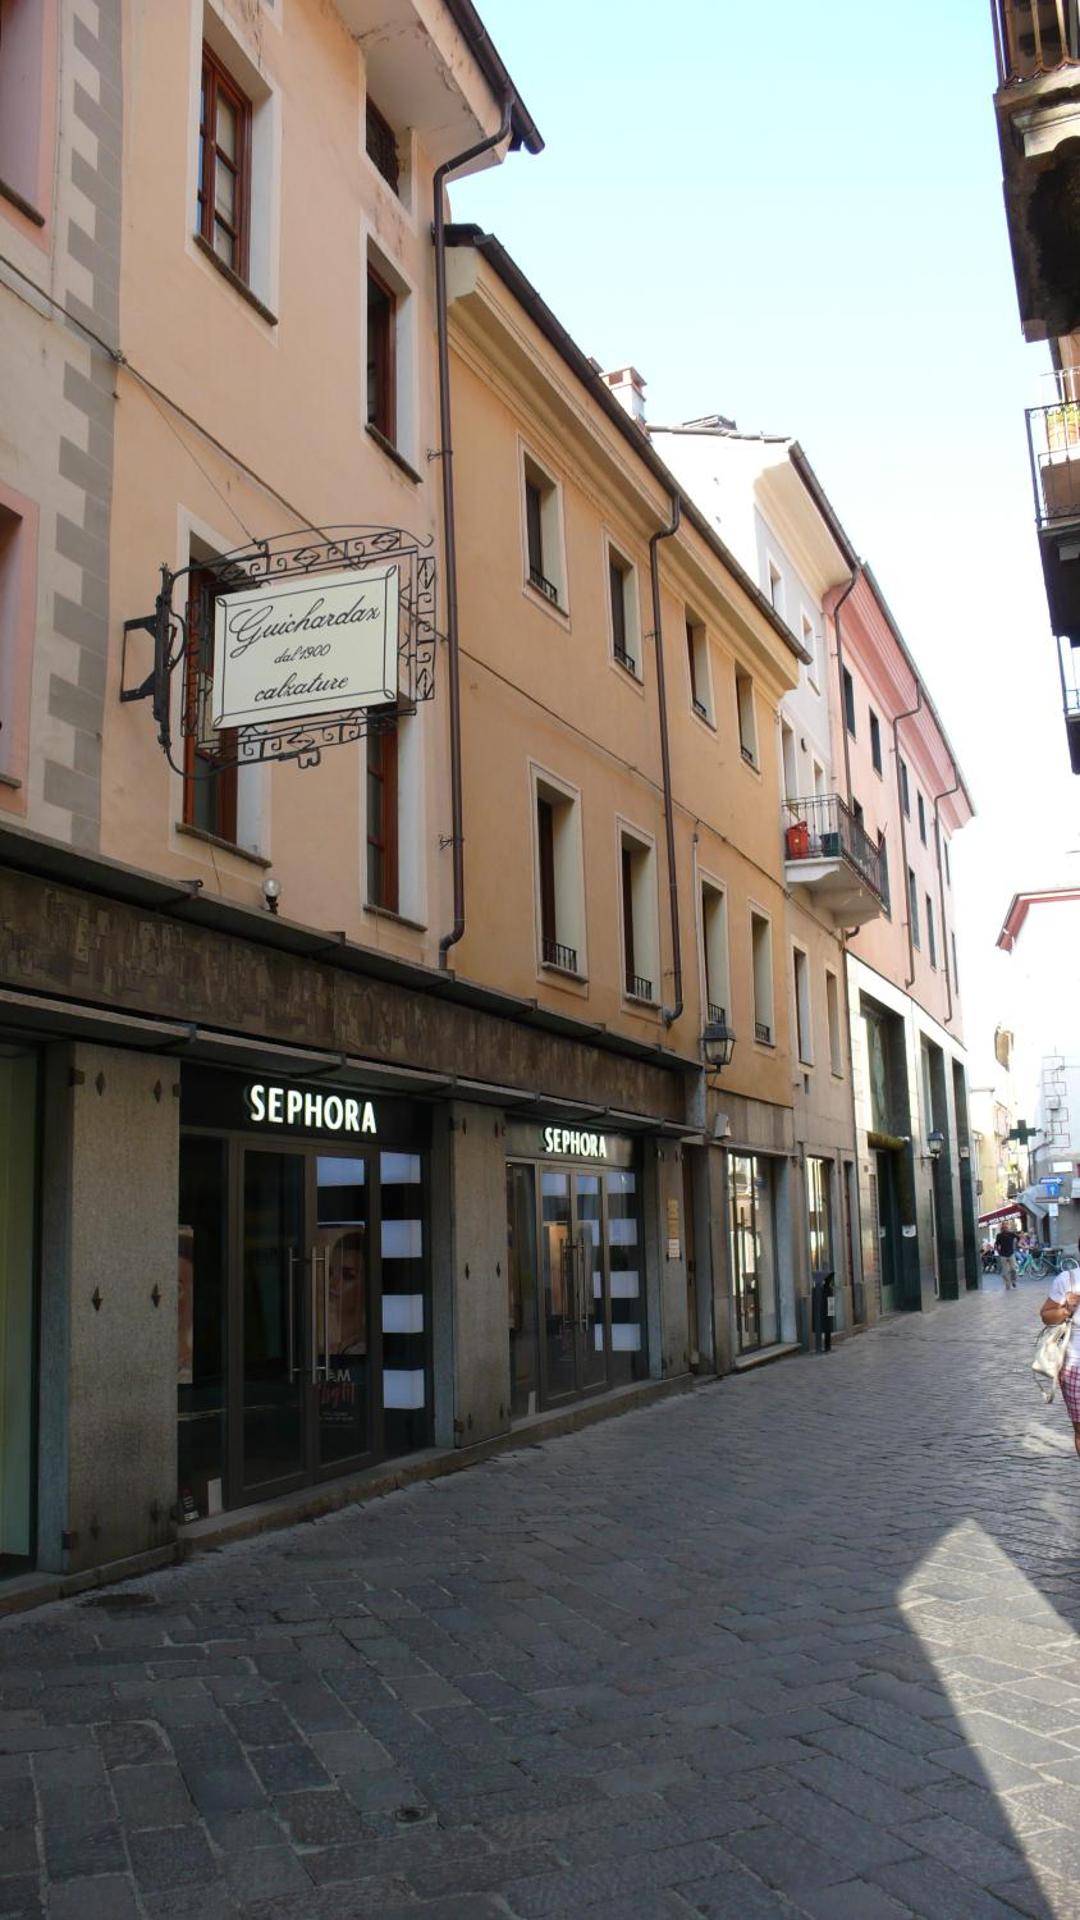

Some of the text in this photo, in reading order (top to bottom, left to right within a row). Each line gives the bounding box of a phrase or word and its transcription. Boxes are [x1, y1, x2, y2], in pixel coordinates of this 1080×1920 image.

[274, 643, 331, 664] dal 1900
[254, 672, 349, 702] calzature
[250, 1084, 377, 1134] SEPHORA
[544, 1126, 607, 1158] SEPHORA
